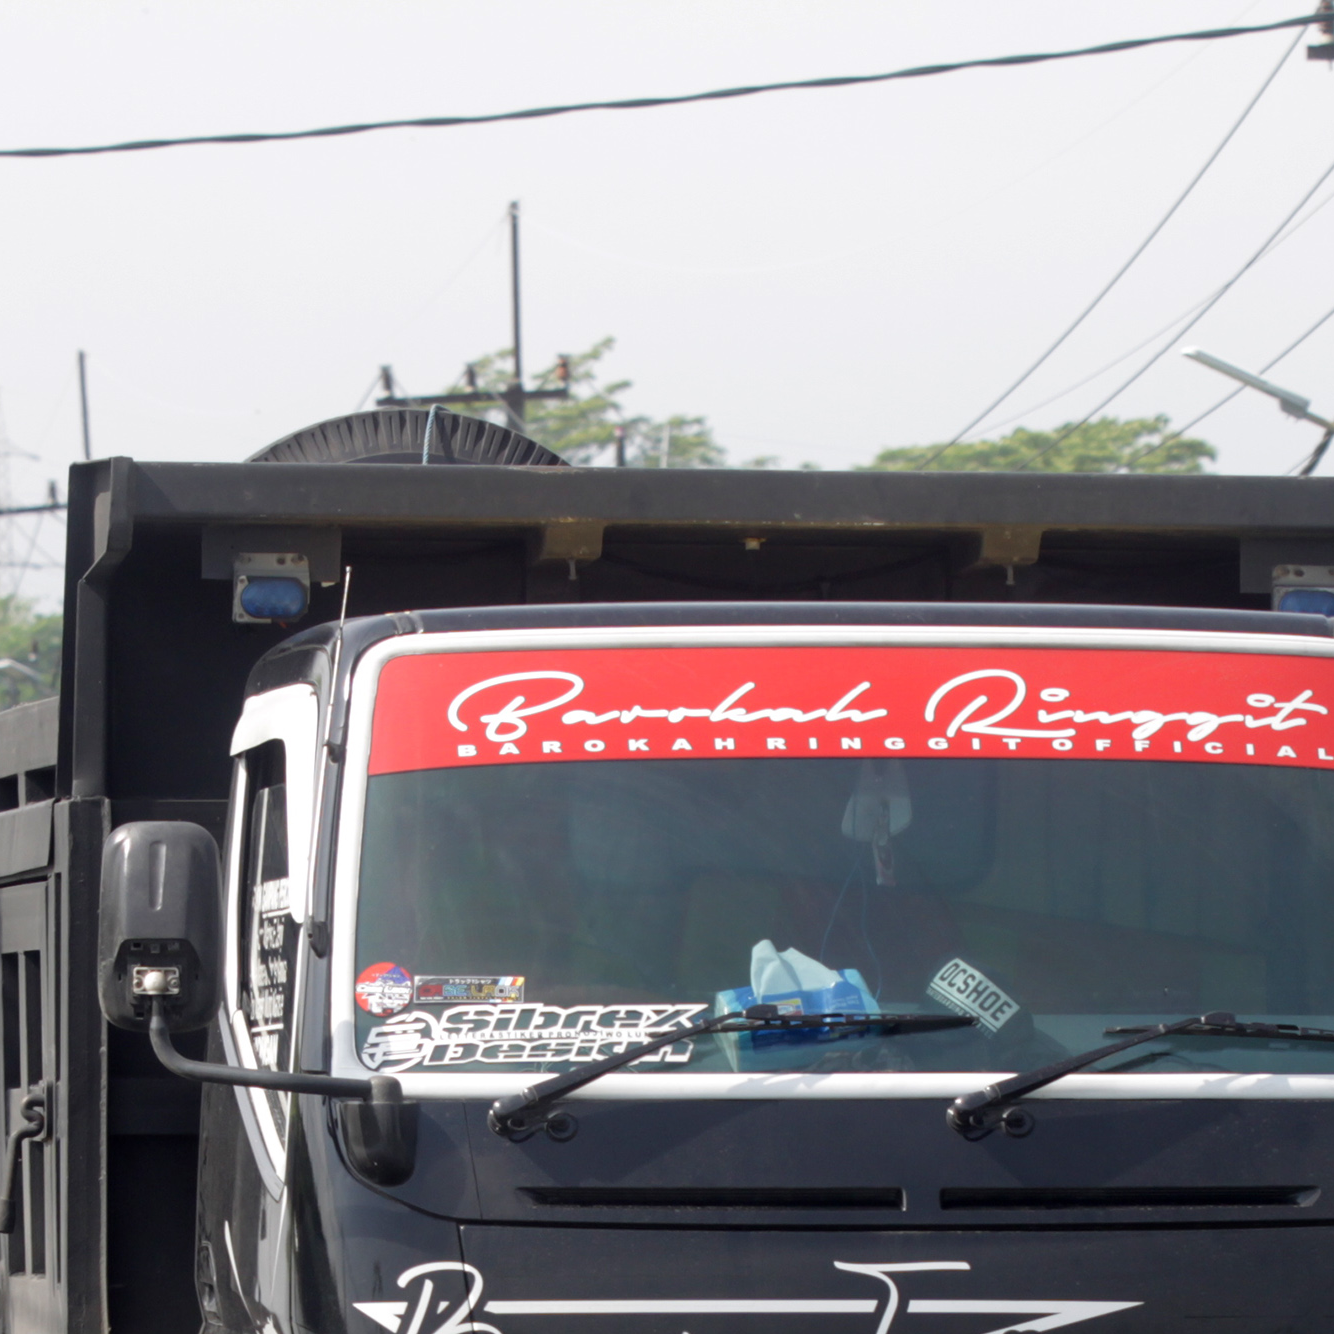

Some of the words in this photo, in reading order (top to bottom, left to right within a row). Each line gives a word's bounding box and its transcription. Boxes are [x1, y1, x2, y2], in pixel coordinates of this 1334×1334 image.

[446, 669, 889, 743] Barokah
[924, 667, 1330, 743] Ringgit
[455, 737, 737, 759] BAROKAH
[766, 736, 1023, 752] RINGGIT
